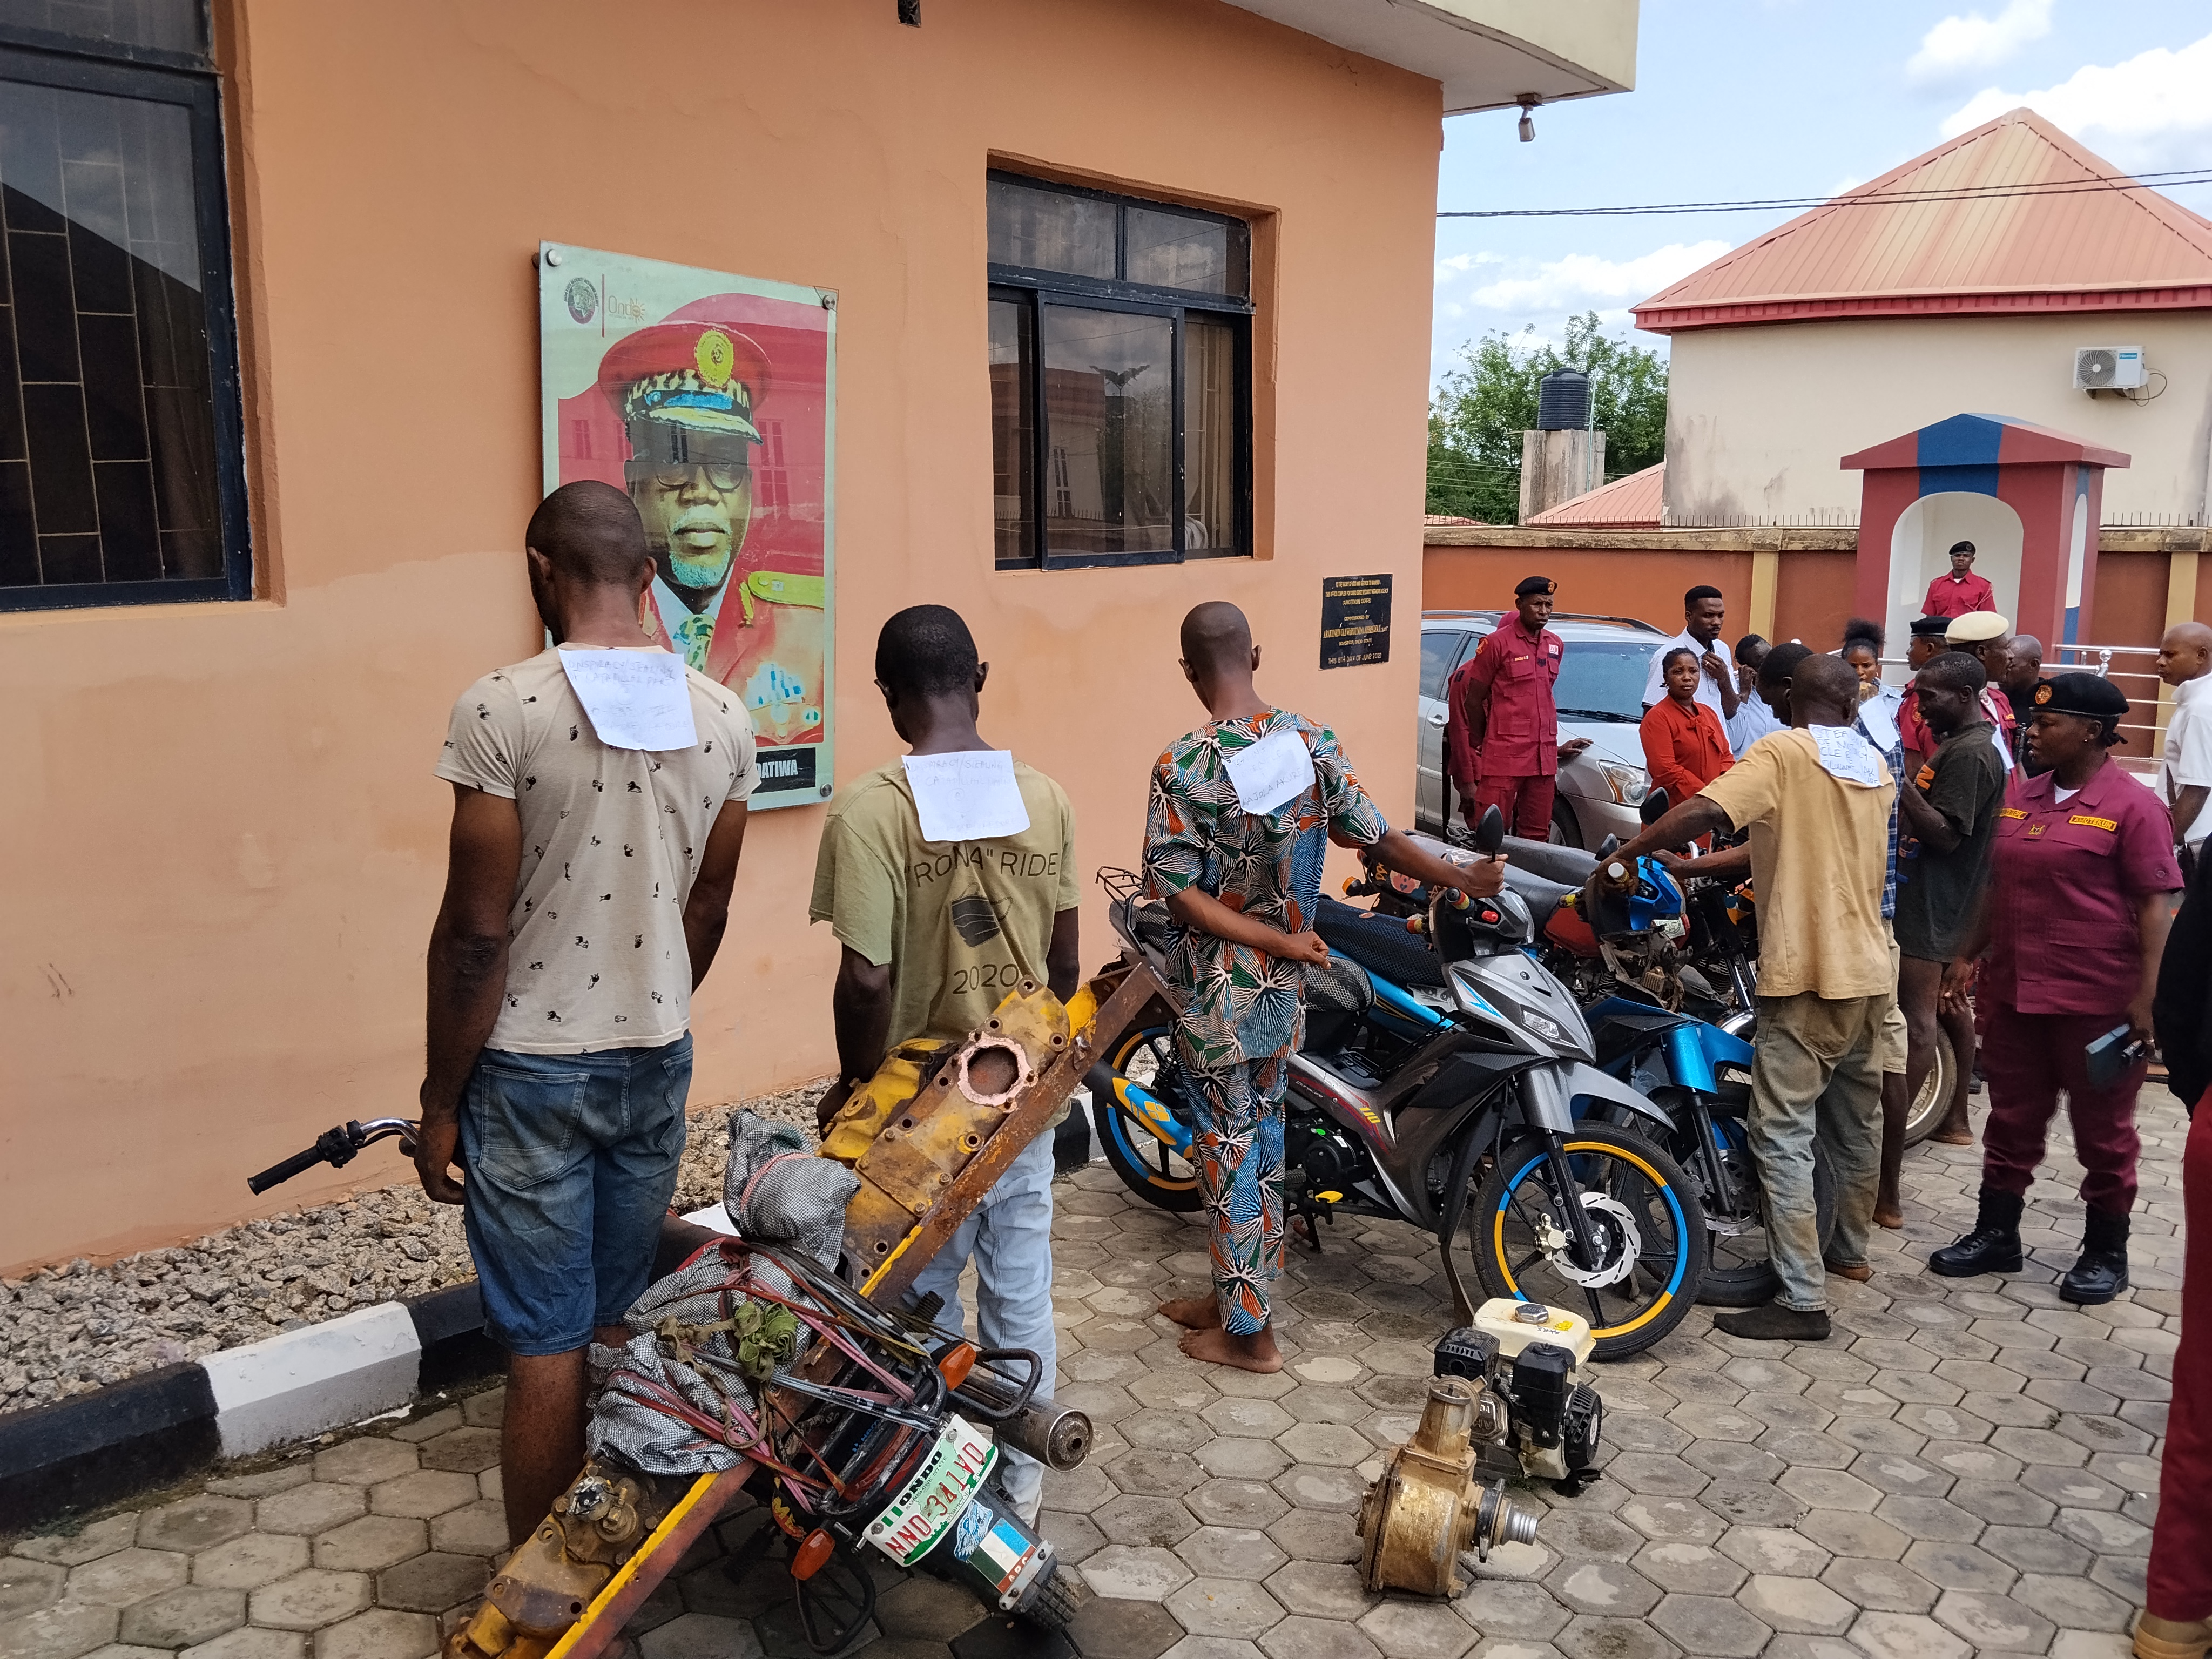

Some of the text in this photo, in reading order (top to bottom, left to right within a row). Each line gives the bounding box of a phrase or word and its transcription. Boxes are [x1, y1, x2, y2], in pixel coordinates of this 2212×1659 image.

[1242, 767, 1305, 808] KAJOLA AKURE
[2075, 817, 2112, 829] AMOTEKUN
[1000, 850, 1058, 878] RIDE
[952, 963, 1020, 995] 2020
[898, 1450, 943, 1507] ONDO
[905, 1455, 949, 1510] SUNSHINE STATE
